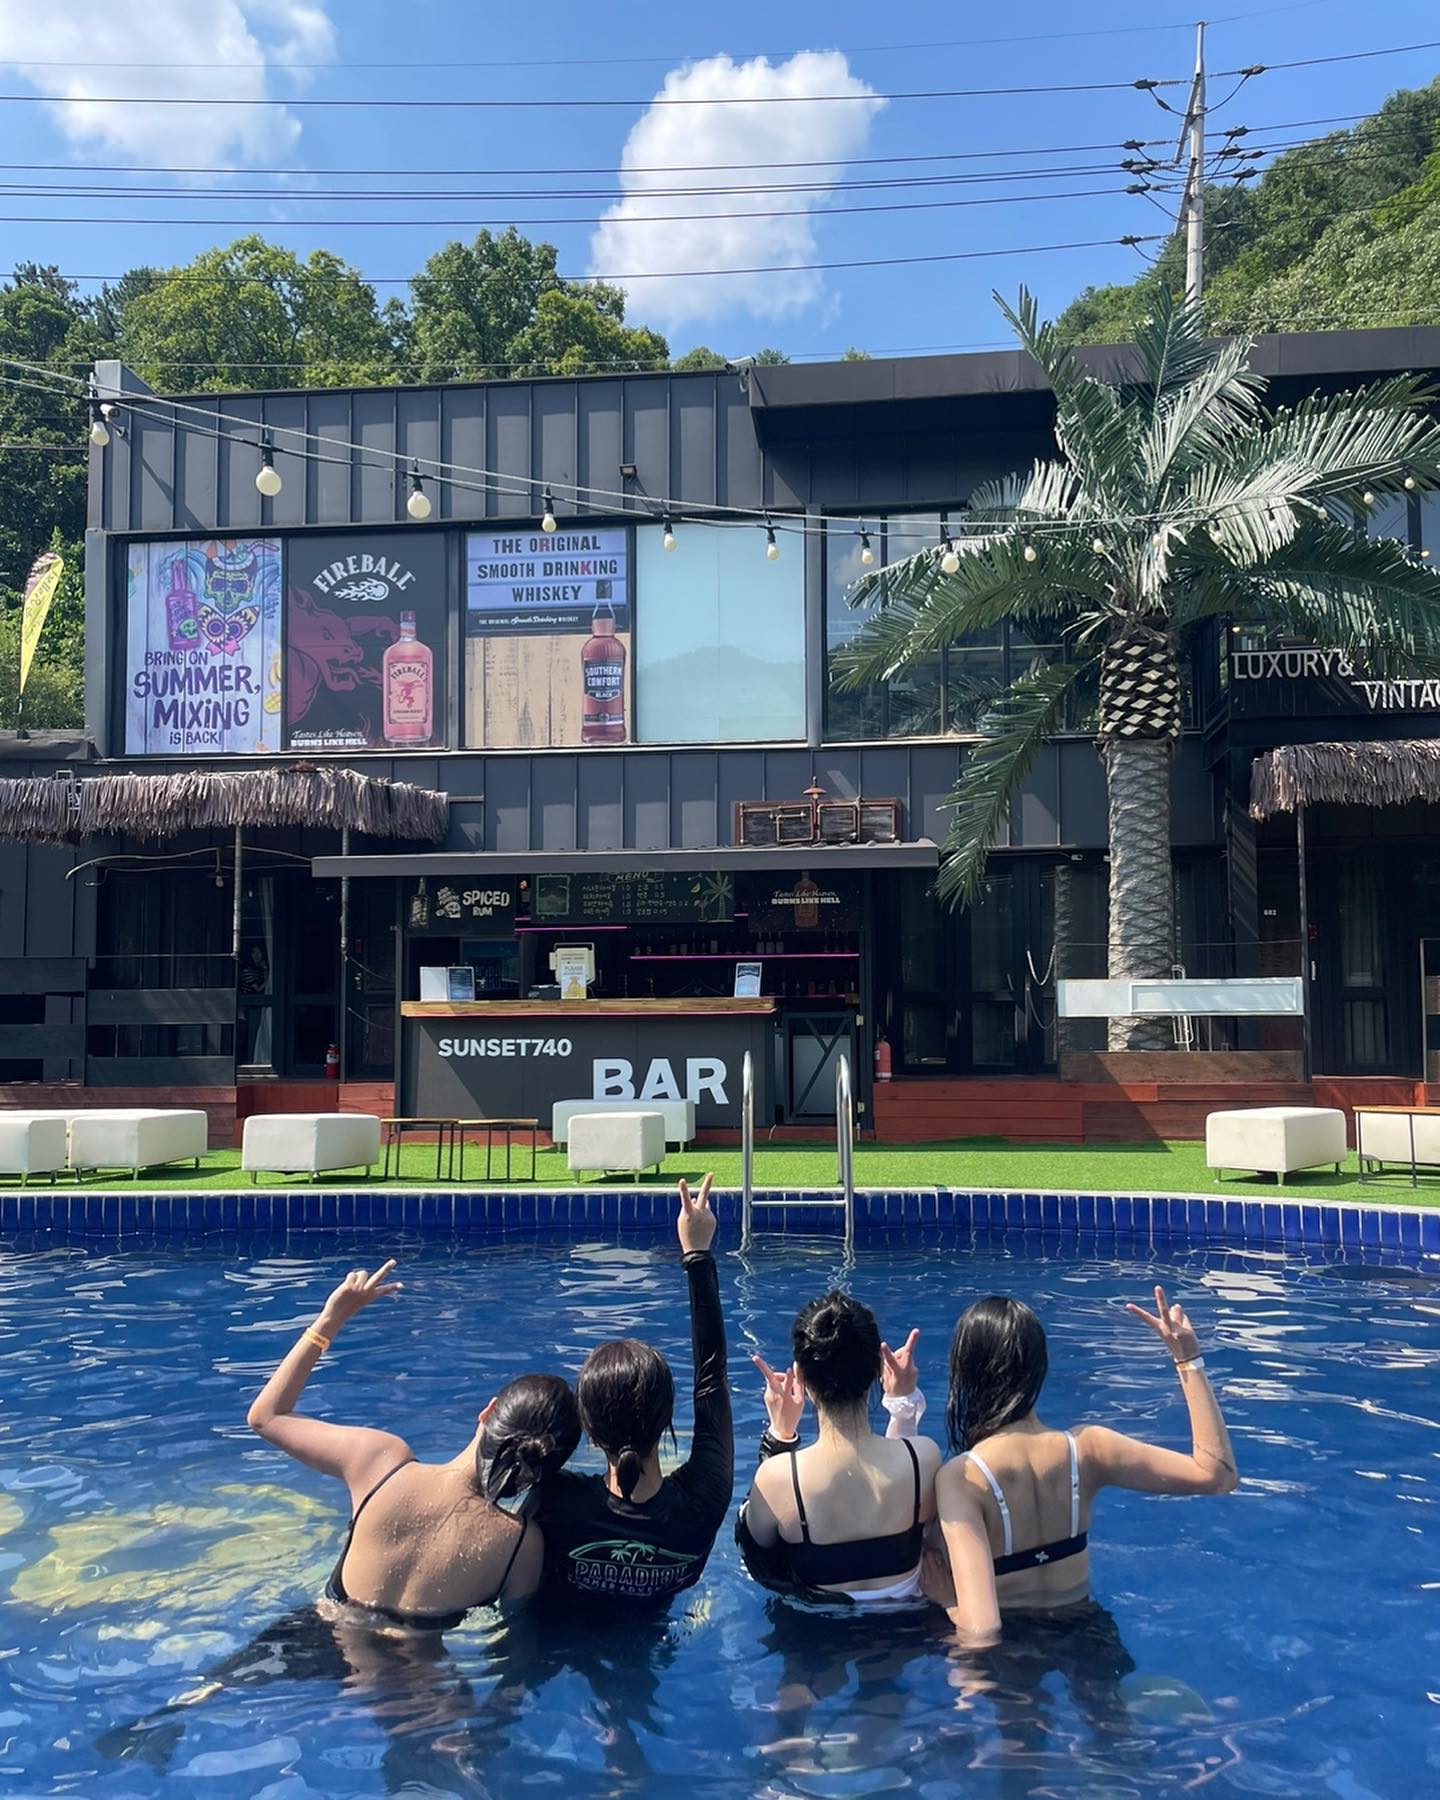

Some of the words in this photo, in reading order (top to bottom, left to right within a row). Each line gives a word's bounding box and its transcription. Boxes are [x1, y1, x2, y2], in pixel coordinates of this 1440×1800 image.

[493, 538, 522, 554] THE
[529, 535, 601, 553] ORIGINAL
[313, 553, 417, 594] FIREBALL
[477, 562, 535, 579] SMOOTH
[543, 559, 618, 577] DRINKING
[512, 585, 582, 602] WHISKEY
[145, 651, 184, 666] BRING
[189, 650, 208, 666] ON
[585, 666, 622, 677] SOUTHERN
[133, 665, 261, 698] SUMMER,
[587, 676, 620, 687] COMFORT
[462, 890, 510, 906] SPICED
[472, 906, 493, 917] RUM
[438, 1038, 573, 1057] SUNSET740
[593, 1058, 730, 1105] BAR
